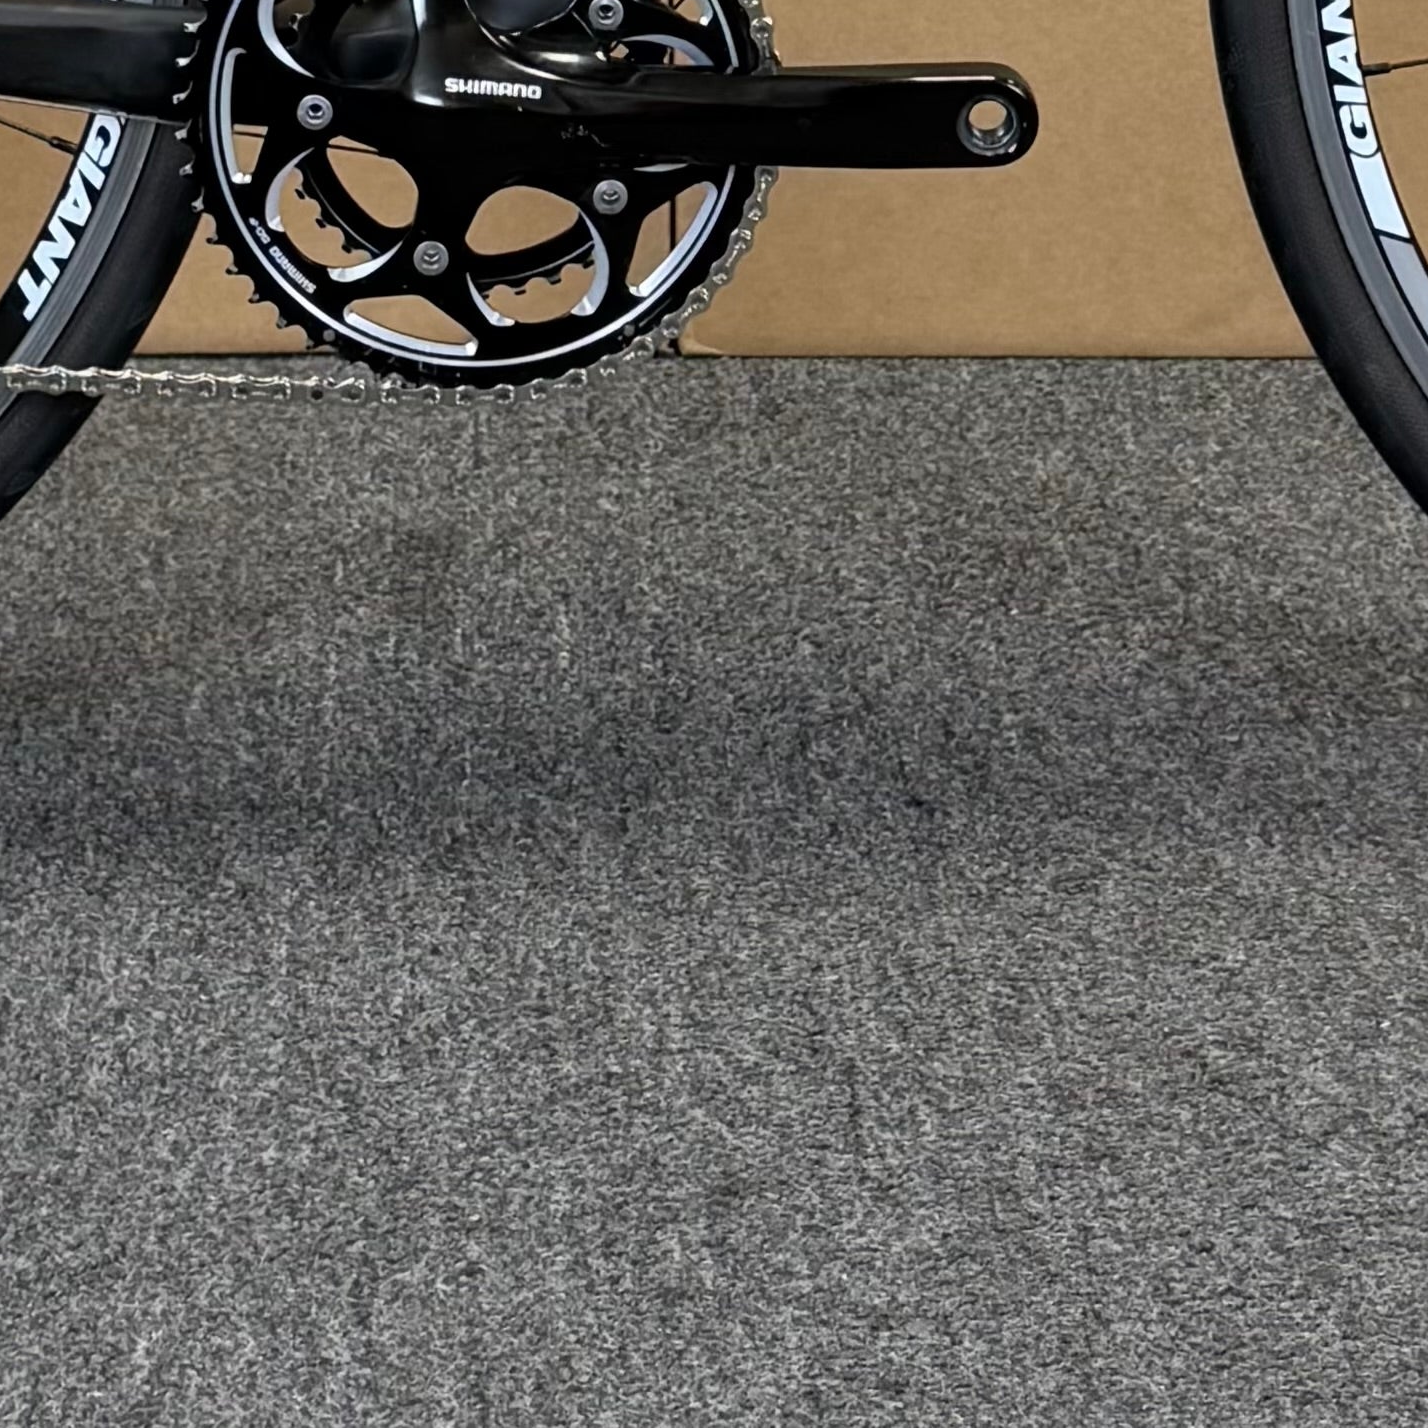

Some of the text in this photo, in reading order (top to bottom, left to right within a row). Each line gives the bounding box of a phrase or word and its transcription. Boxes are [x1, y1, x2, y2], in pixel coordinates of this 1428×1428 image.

[444, 77, 543, 101] SHIMANO
[17, 113, 126, 322] GIANT
[268, 245, 317, 294] SHIMANO
